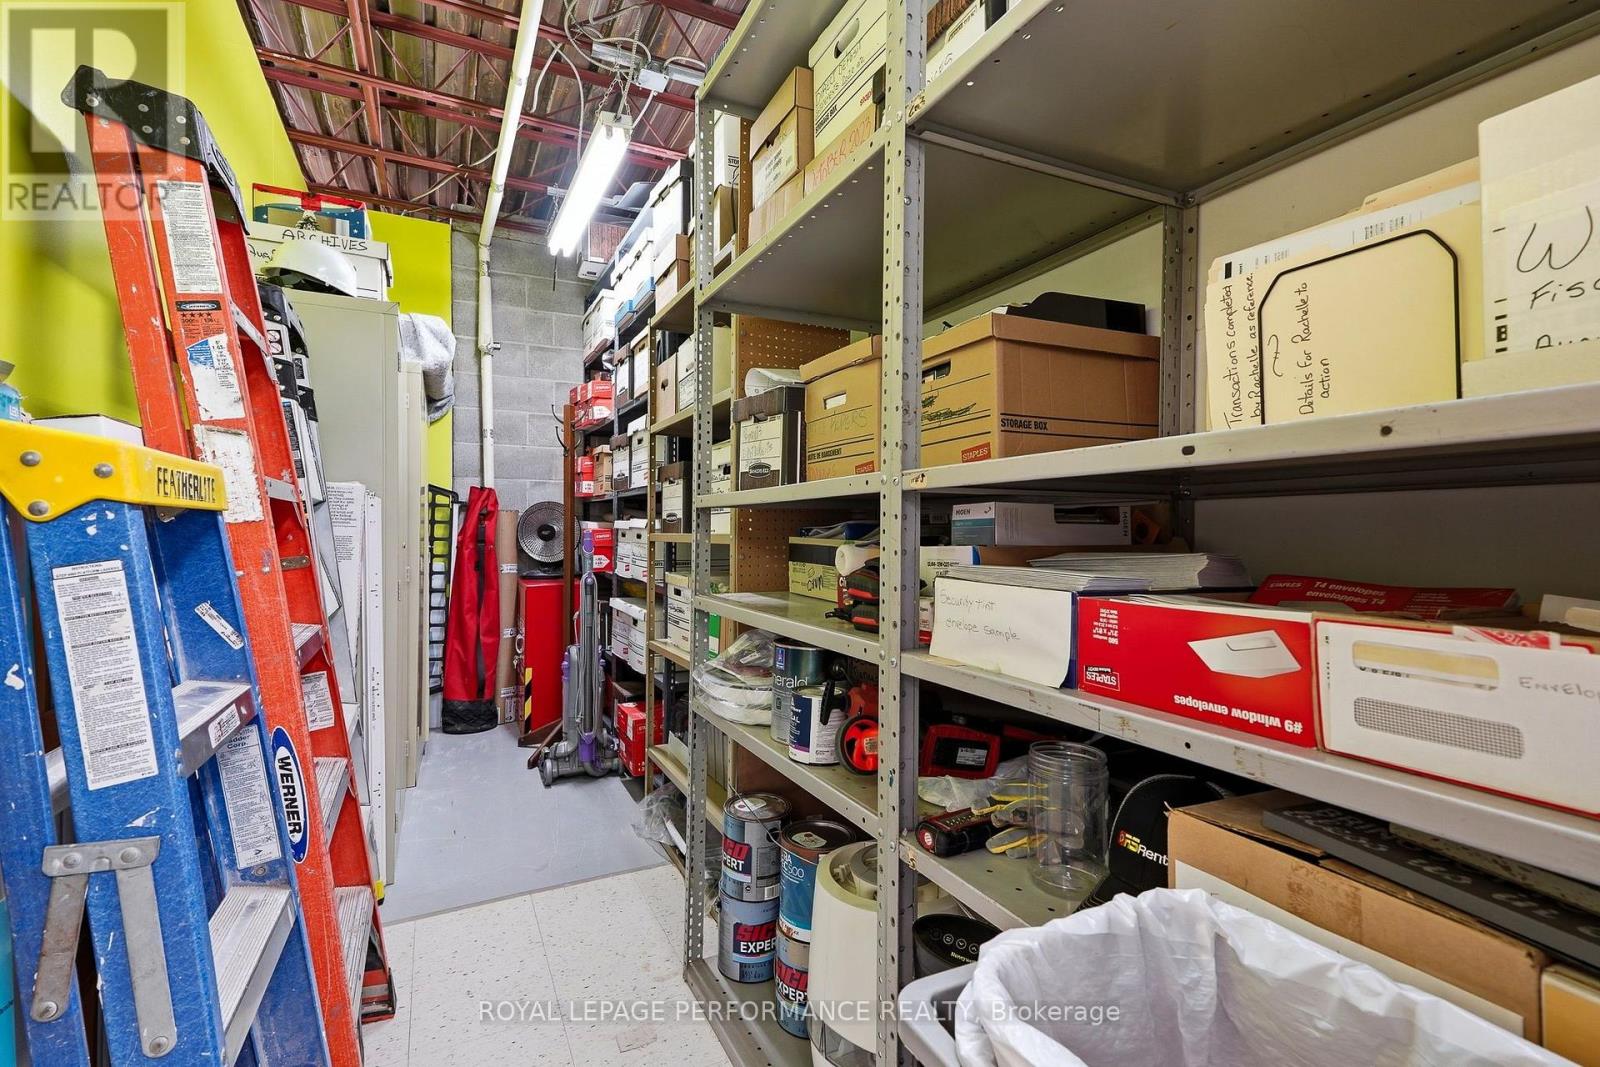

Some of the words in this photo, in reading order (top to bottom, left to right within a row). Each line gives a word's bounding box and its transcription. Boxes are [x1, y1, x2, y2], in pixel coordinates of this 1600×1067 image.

[282, 229, 368, 251] ARCHIVES
[1294, 282, 1308, 295] to
[1220, 285, 1238, 337] completed
[1249, 325, 1257, 339] as
[1223, 340, 1242, 429] Transactions
[1319, 358, 1331, 399] action
[1297, 372, 1315, 415] Details
[1000, 417, 1032, 431] STORAGE
[1033, 420, 1049, 431] BOX
[962, 447, 988, 461] STAPLES
[157, 466, 216, 504] FEATHERLITE
[955, 508, 971, 516] MOEN
[1314, 581, 1326, 589] T4
[1328, 583, 1387, 597] envelopes
[1306, 590, 1369, 605] enveloppes
[1370, 598, 1386, 606] T4
[772, 675, 808, 689] erald
[1086, 671, 1117, 686] STAPLES
[1174, 694, 1229, 716] envelopes
[1230, 708, 1281, 729] window
[1285, 719, 1303, 735] #9
[277, 755, 302, 836] WERNER
[722, 853, 745, 872] PERT
